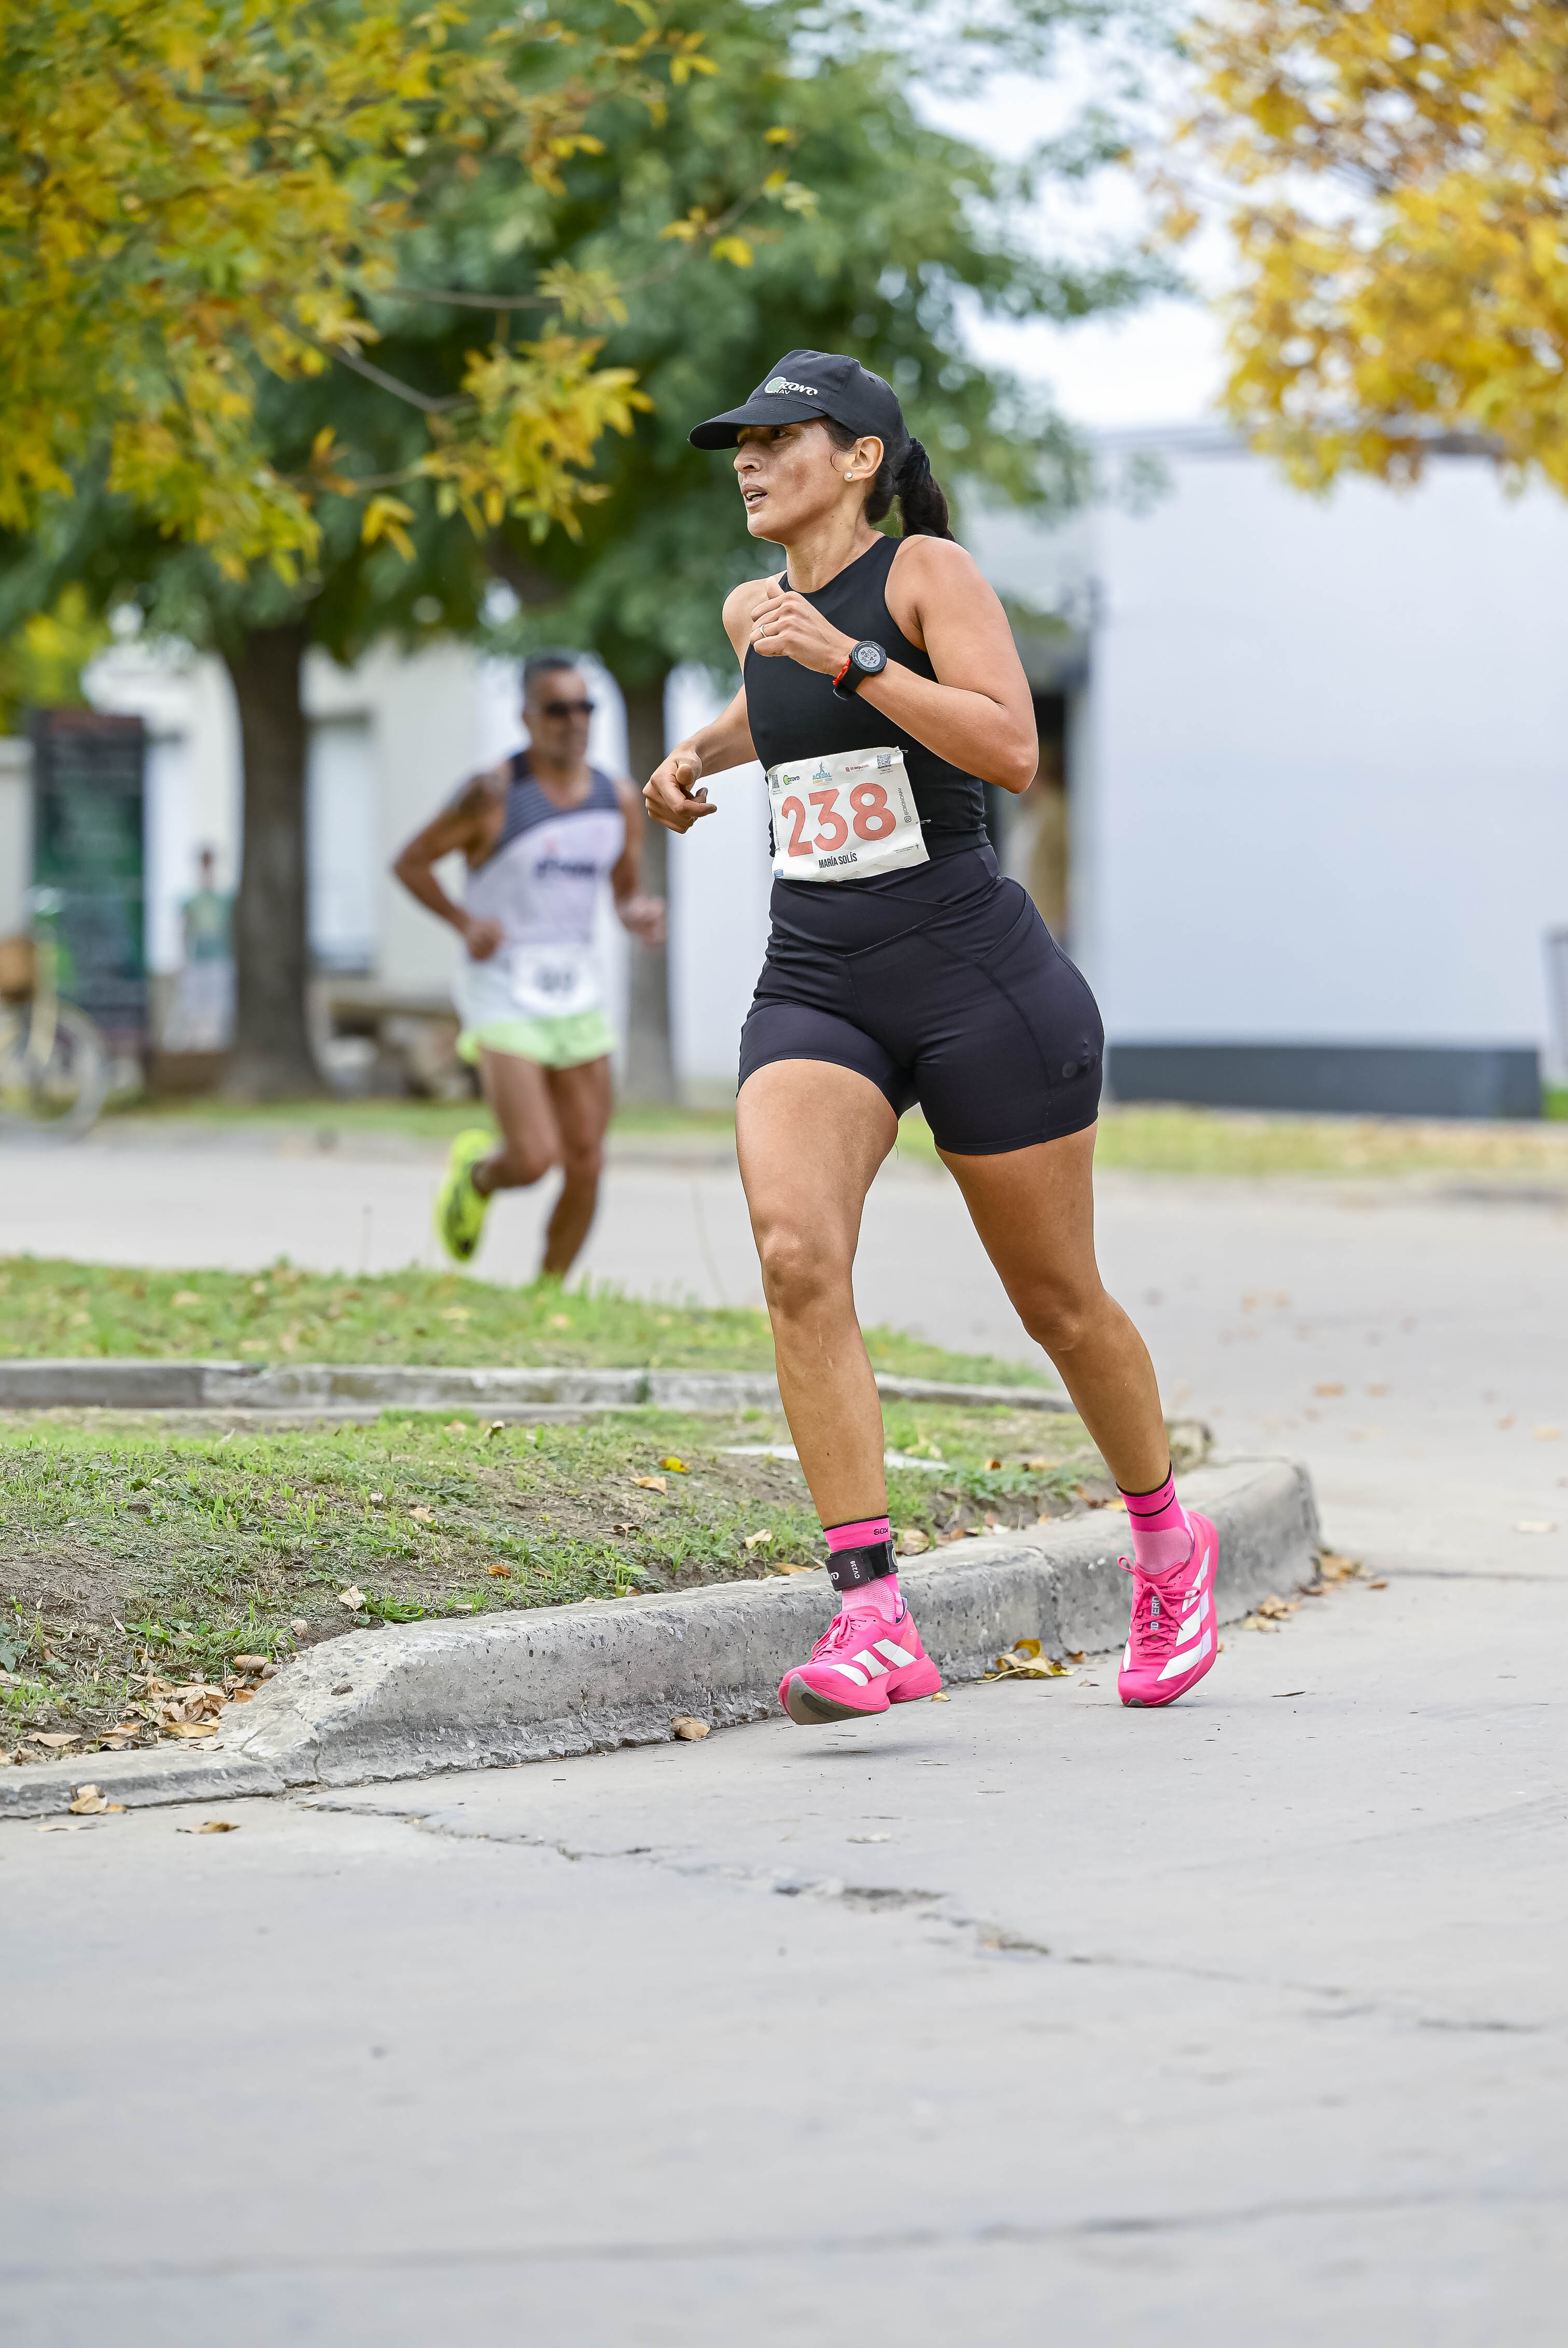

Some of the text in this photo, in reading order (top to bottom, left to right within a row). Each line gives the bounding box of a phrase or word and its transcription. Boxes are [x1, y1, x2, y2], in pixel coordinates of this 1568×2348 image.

[781, 782, 897, 857] 238
[818, 852, 858, 869] MARÍA SOLÍS
[873, 1527, 888, 1535] SOX
[850, 1560, 861, 1580] CV238
